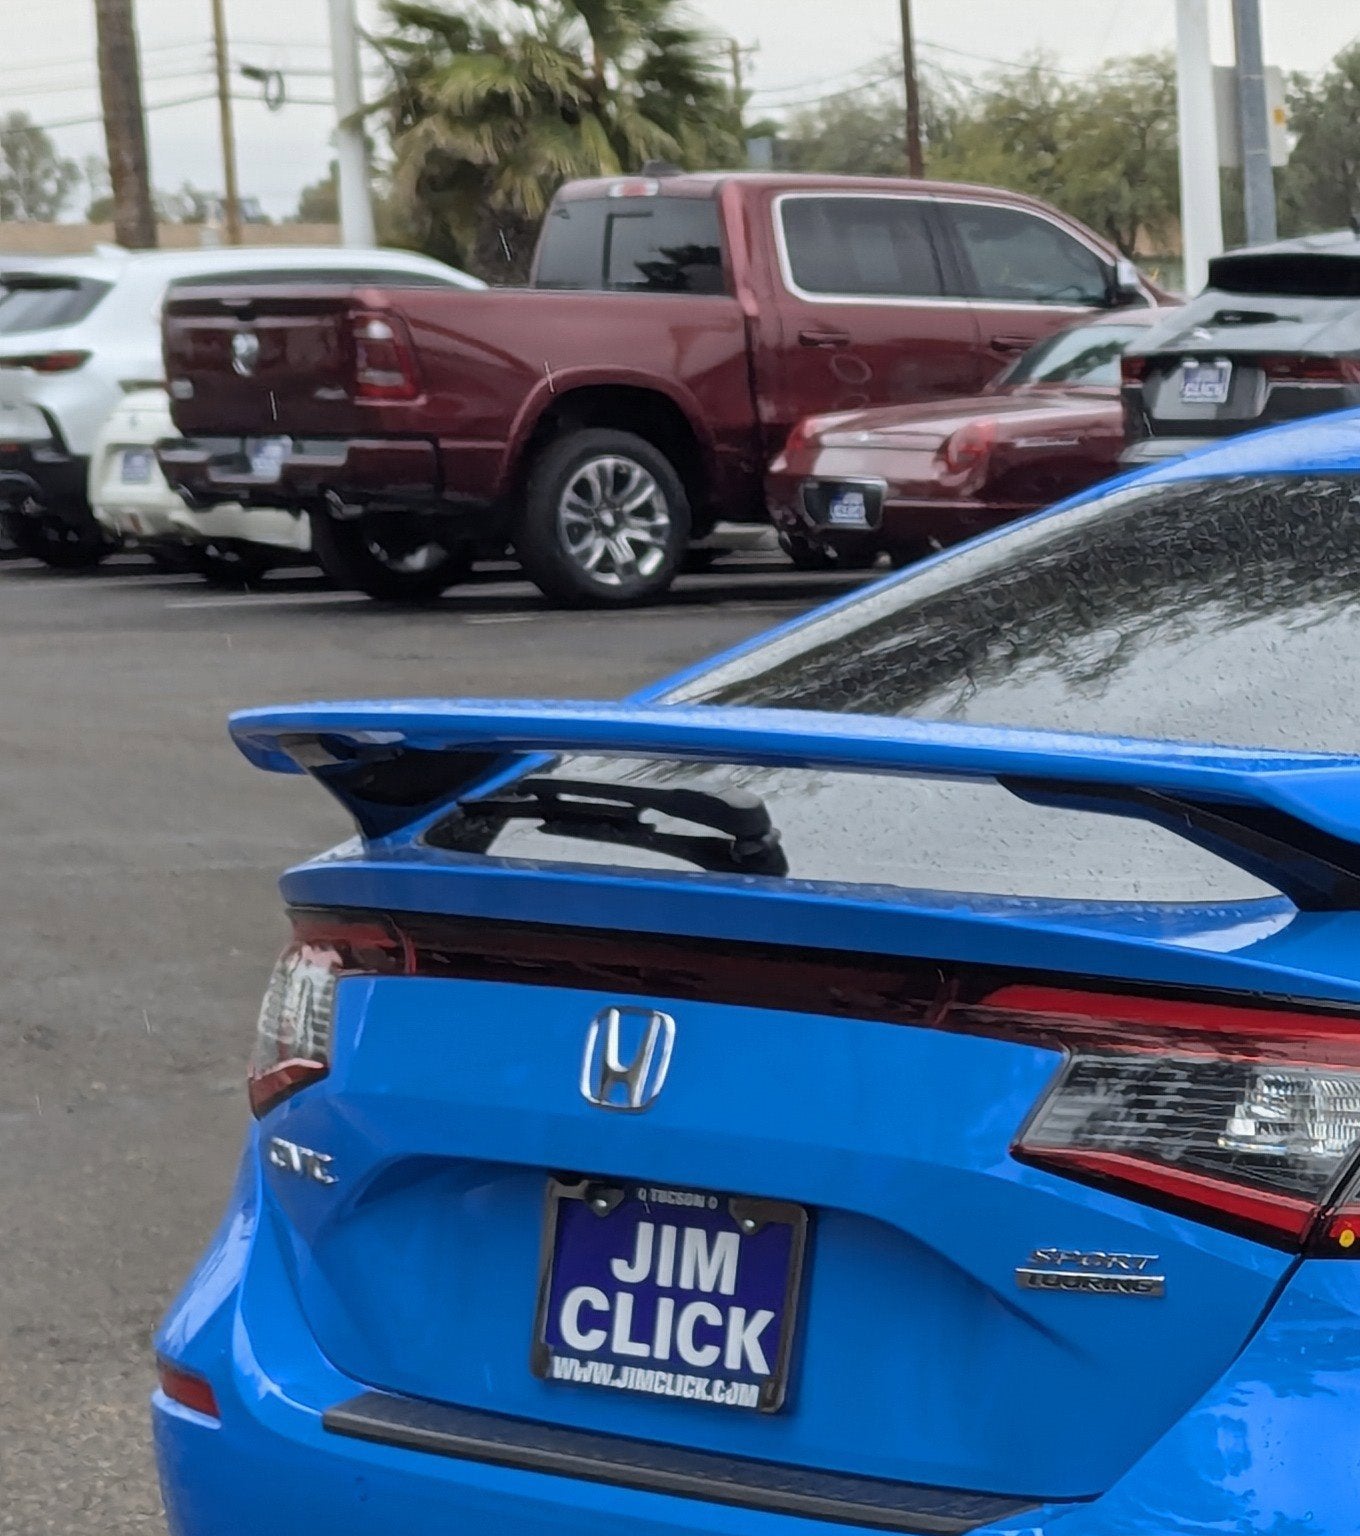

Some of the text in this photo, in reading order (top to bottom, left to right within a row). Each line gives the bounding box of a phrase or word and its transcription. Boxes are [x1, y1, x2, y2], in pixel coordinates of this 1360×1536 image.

[610, 1220, 740, 1296] JIM
[559, 1286, 775, 1376] CLICK
[552, 1355, 760, 1408] WWW.JIMCLICK.COM
